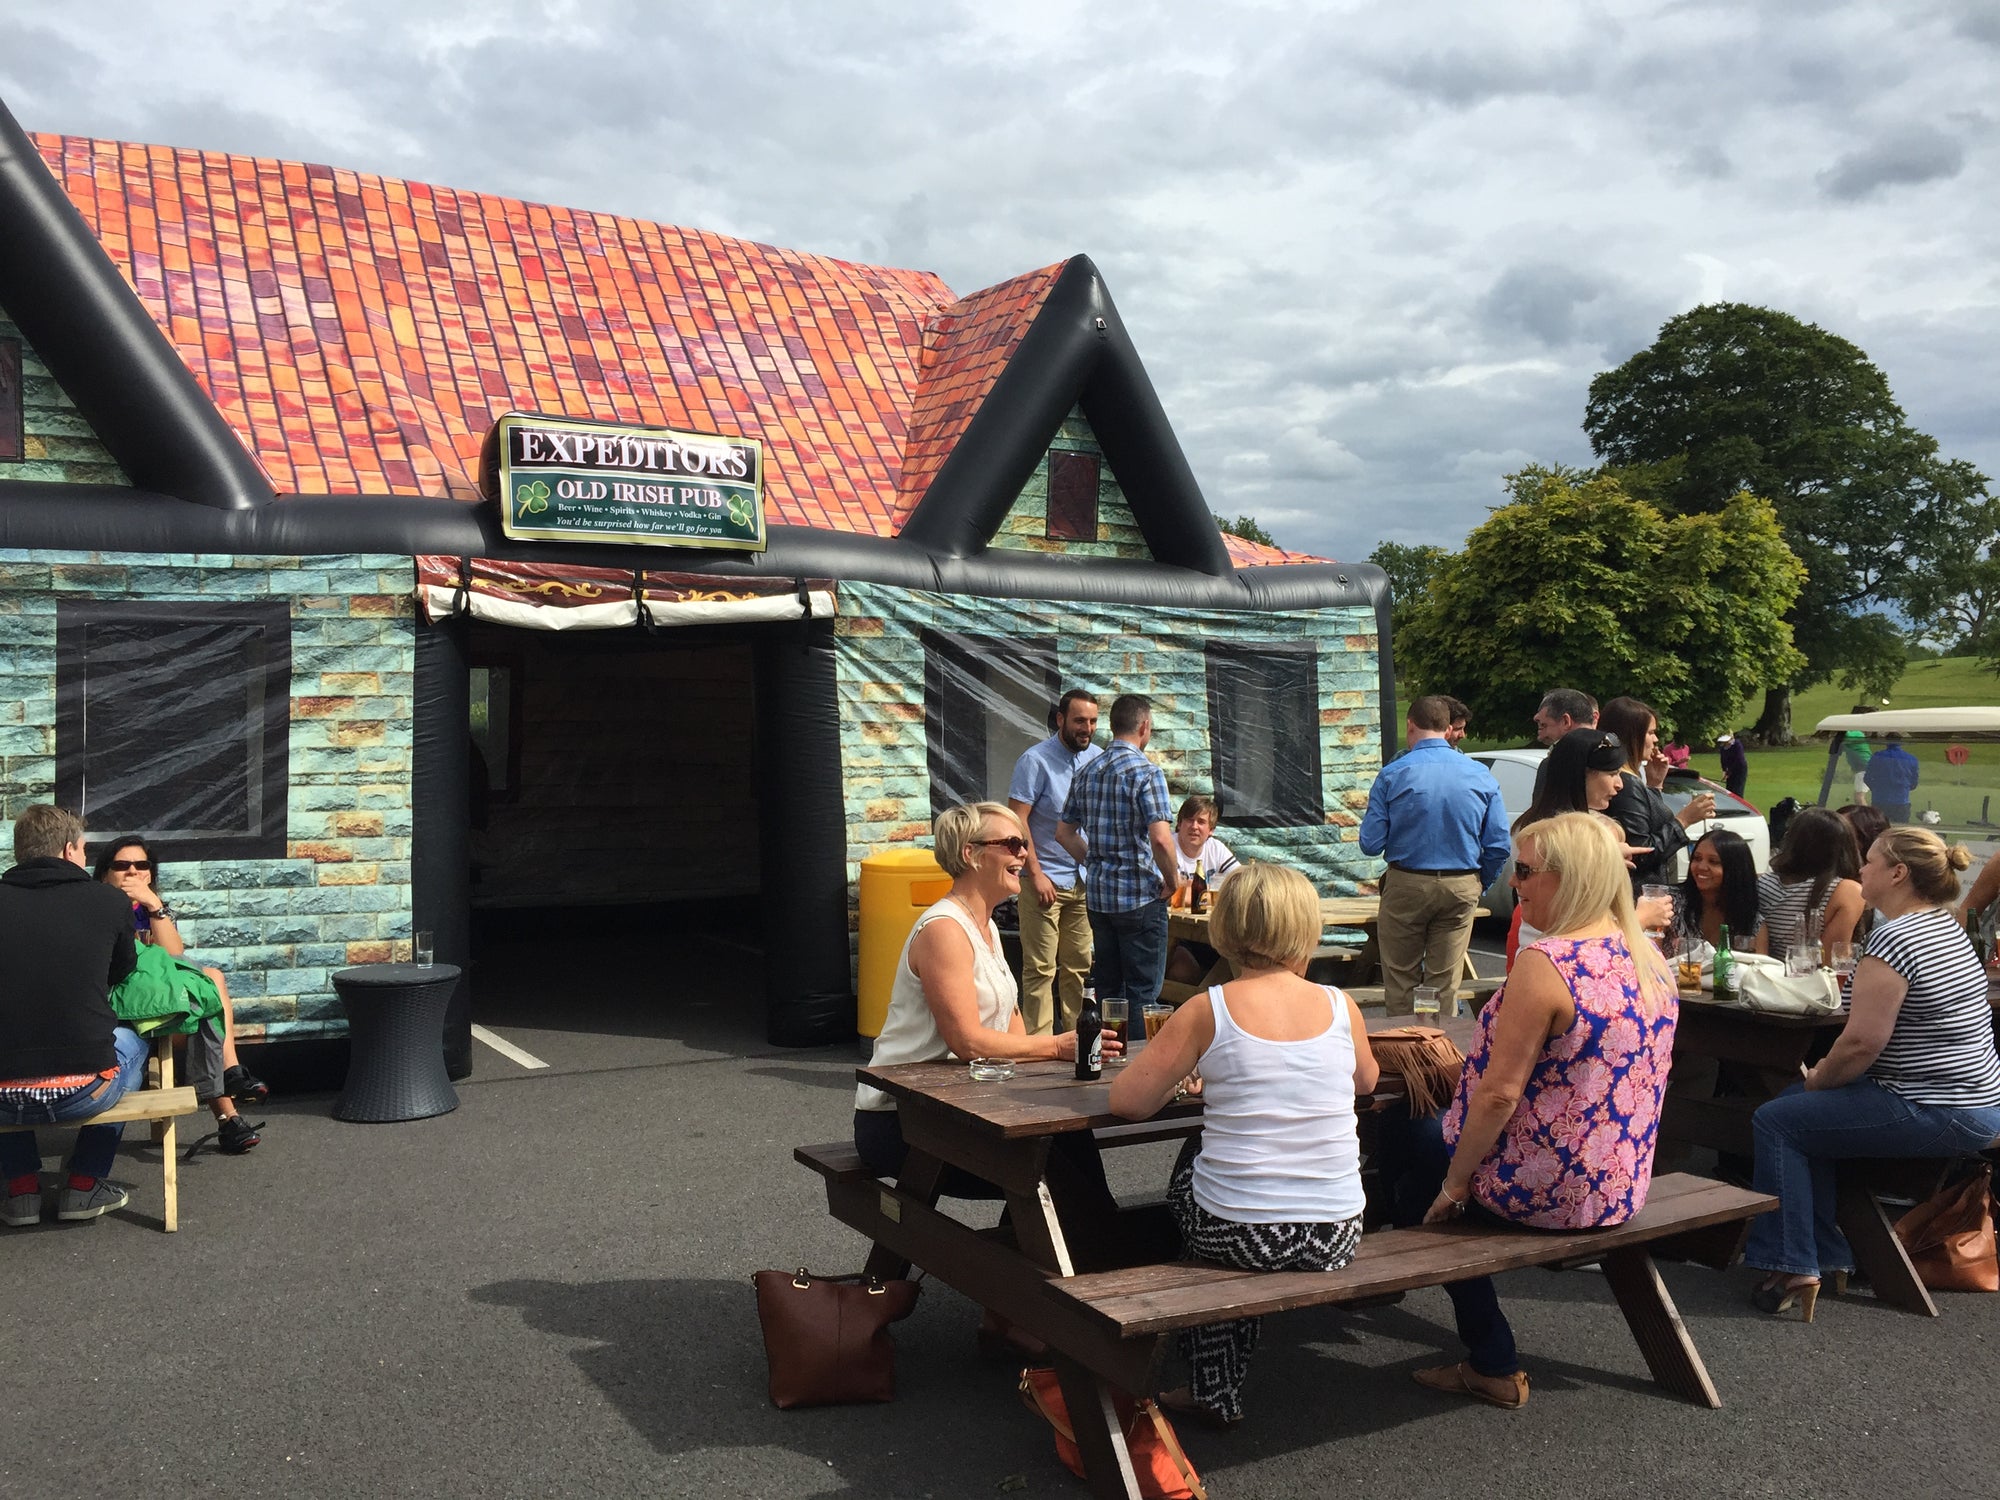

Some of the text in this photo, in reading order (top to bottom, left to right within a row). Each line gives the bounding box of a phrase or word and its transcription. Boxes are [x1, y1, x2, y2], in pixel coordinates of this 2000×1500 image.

[519, 432, 748, 477] EXPEDITORS
[556, 479, 722, 508] OLD IRISH PUB
[558, 503, 722, 520] Beer Wine Spirits Whiskey Vodka Gin
[582, 518, 592, 527] be
[594, 520, 632, 529] surprised
[634, 520, 650, 529] how
[650, 522, 664, 532] far
[686, 525, 695, 533] go
[695, 525, 708, 534] for
[709, 527, 722, 535] you
